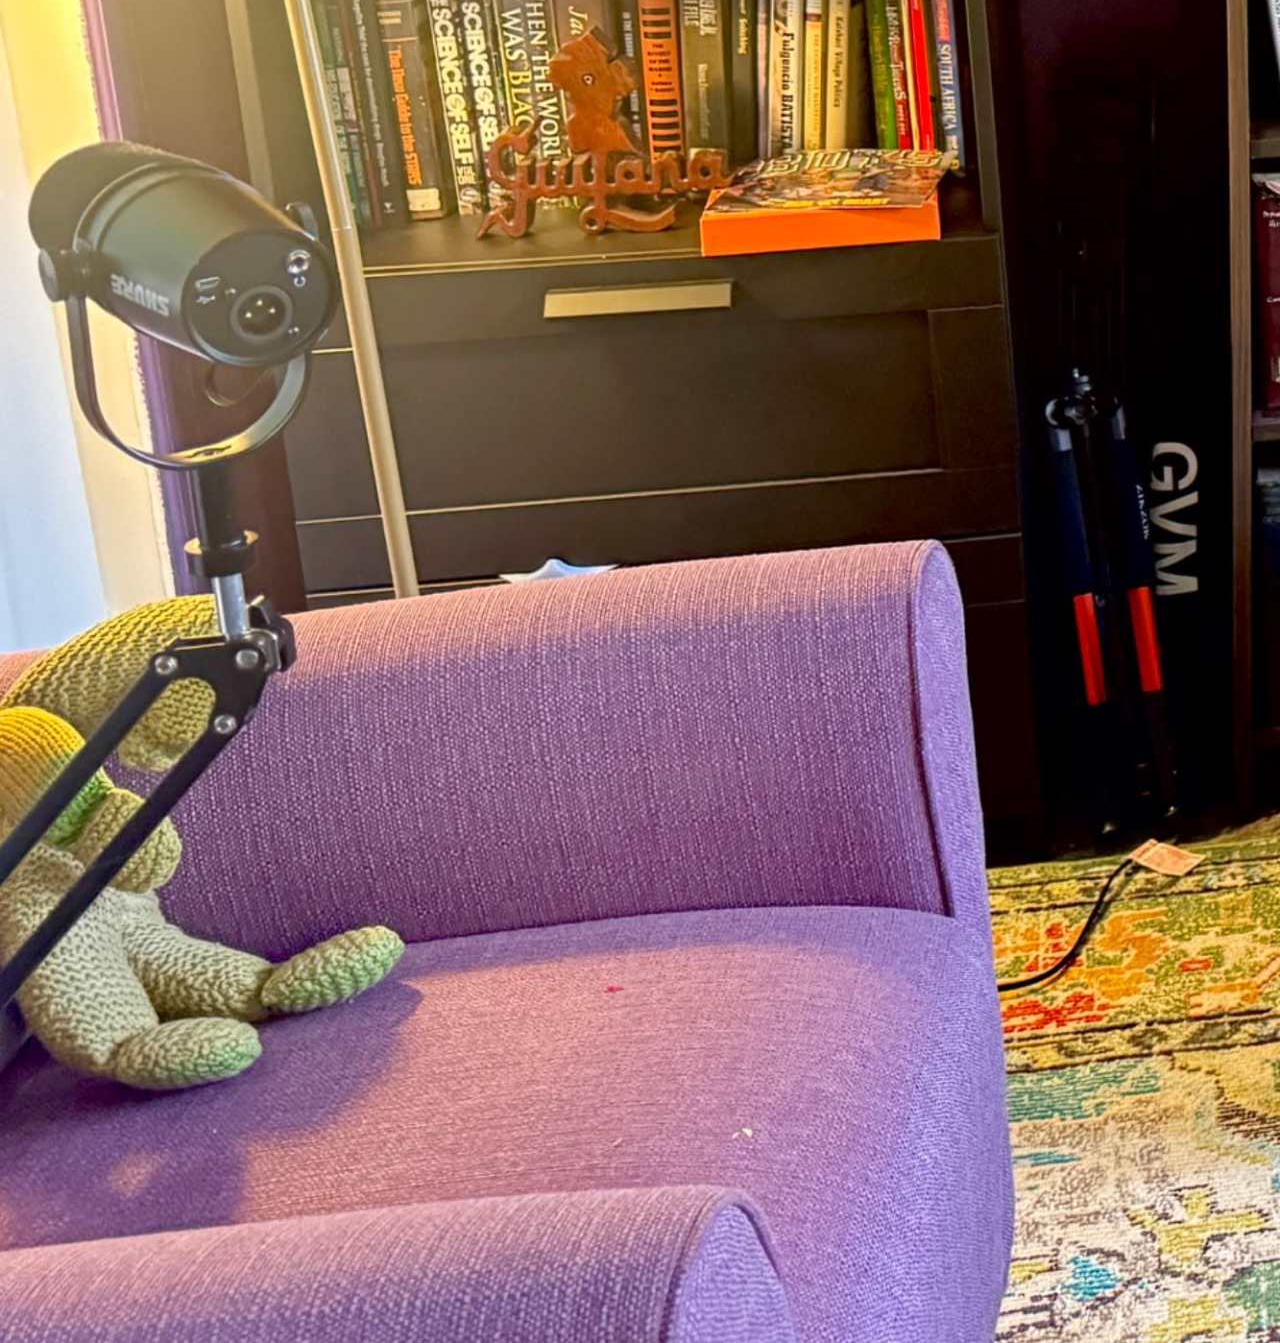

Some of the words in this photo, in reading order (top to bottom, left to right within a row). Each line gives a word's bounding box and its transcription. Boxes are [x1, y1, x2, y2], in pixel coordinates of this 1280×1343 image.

[433, 9, 462, 94] SCIENCE
[780, 32, 795, 91] Fulgencio
[938, 44, 952, 85] SOUTH
[445, 94, 468, 120] OF
[780, 94, 795, 151] BATISTA
[942, 89, 957, 130] AFRICA
[450, 122, 473, 163] SELF
[110, 274, 170, 317] SHURE
[1150, 442, 1198, 595] GVM
